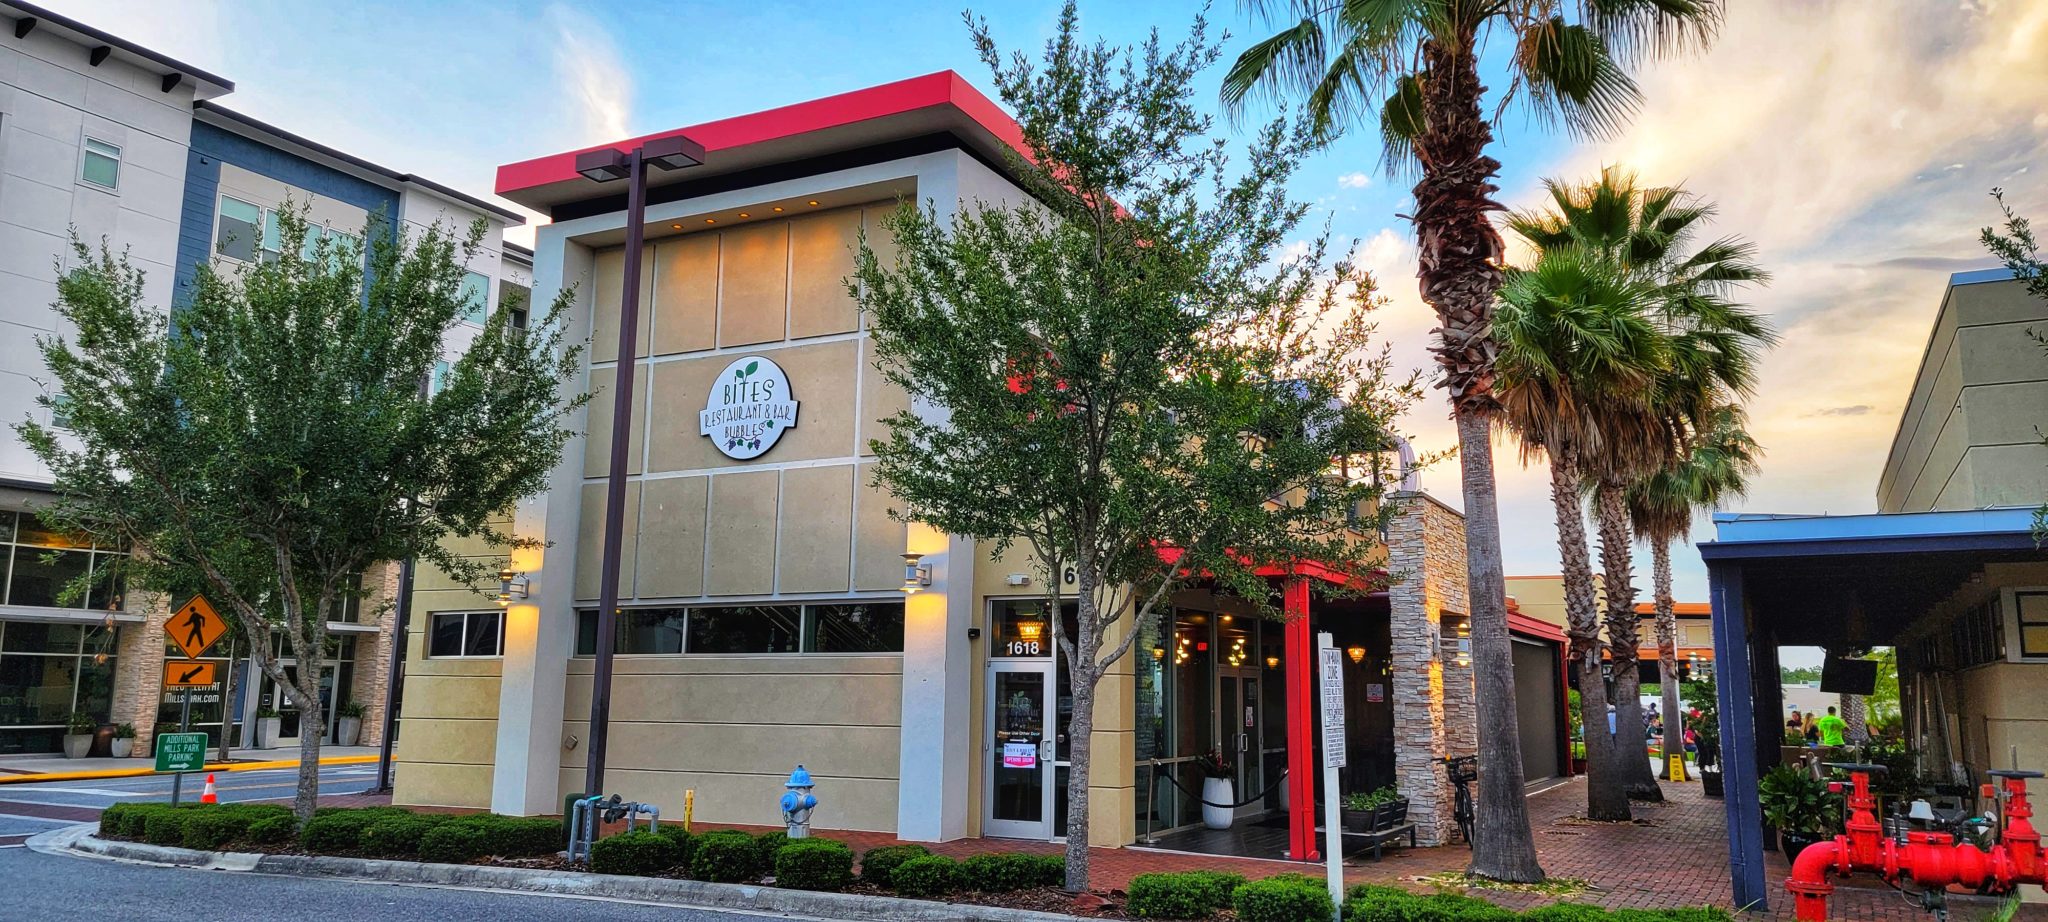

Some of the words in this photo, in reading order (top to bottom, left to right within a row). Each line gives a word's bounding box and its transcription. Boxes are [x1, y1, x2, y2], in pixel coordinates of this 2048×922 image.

[724, 376, 775, 405] BITES
[705, 404, 762, 429] RESTAURANT
[765, 404, 771, 419] &
[773, 404, 792, 421] BAR
[724, 422, 766, 439] BUBBLES
[1007, 641, 1039, 655] 1618
[1327, 665, 1338, 680] ZONE
[167, 735, 200, 743] ADDITIONAL
[164, 744, 181, 753] MILLS
[183, 744, 200, 753] PARK
[168, 753, 193, 762] PARKING
